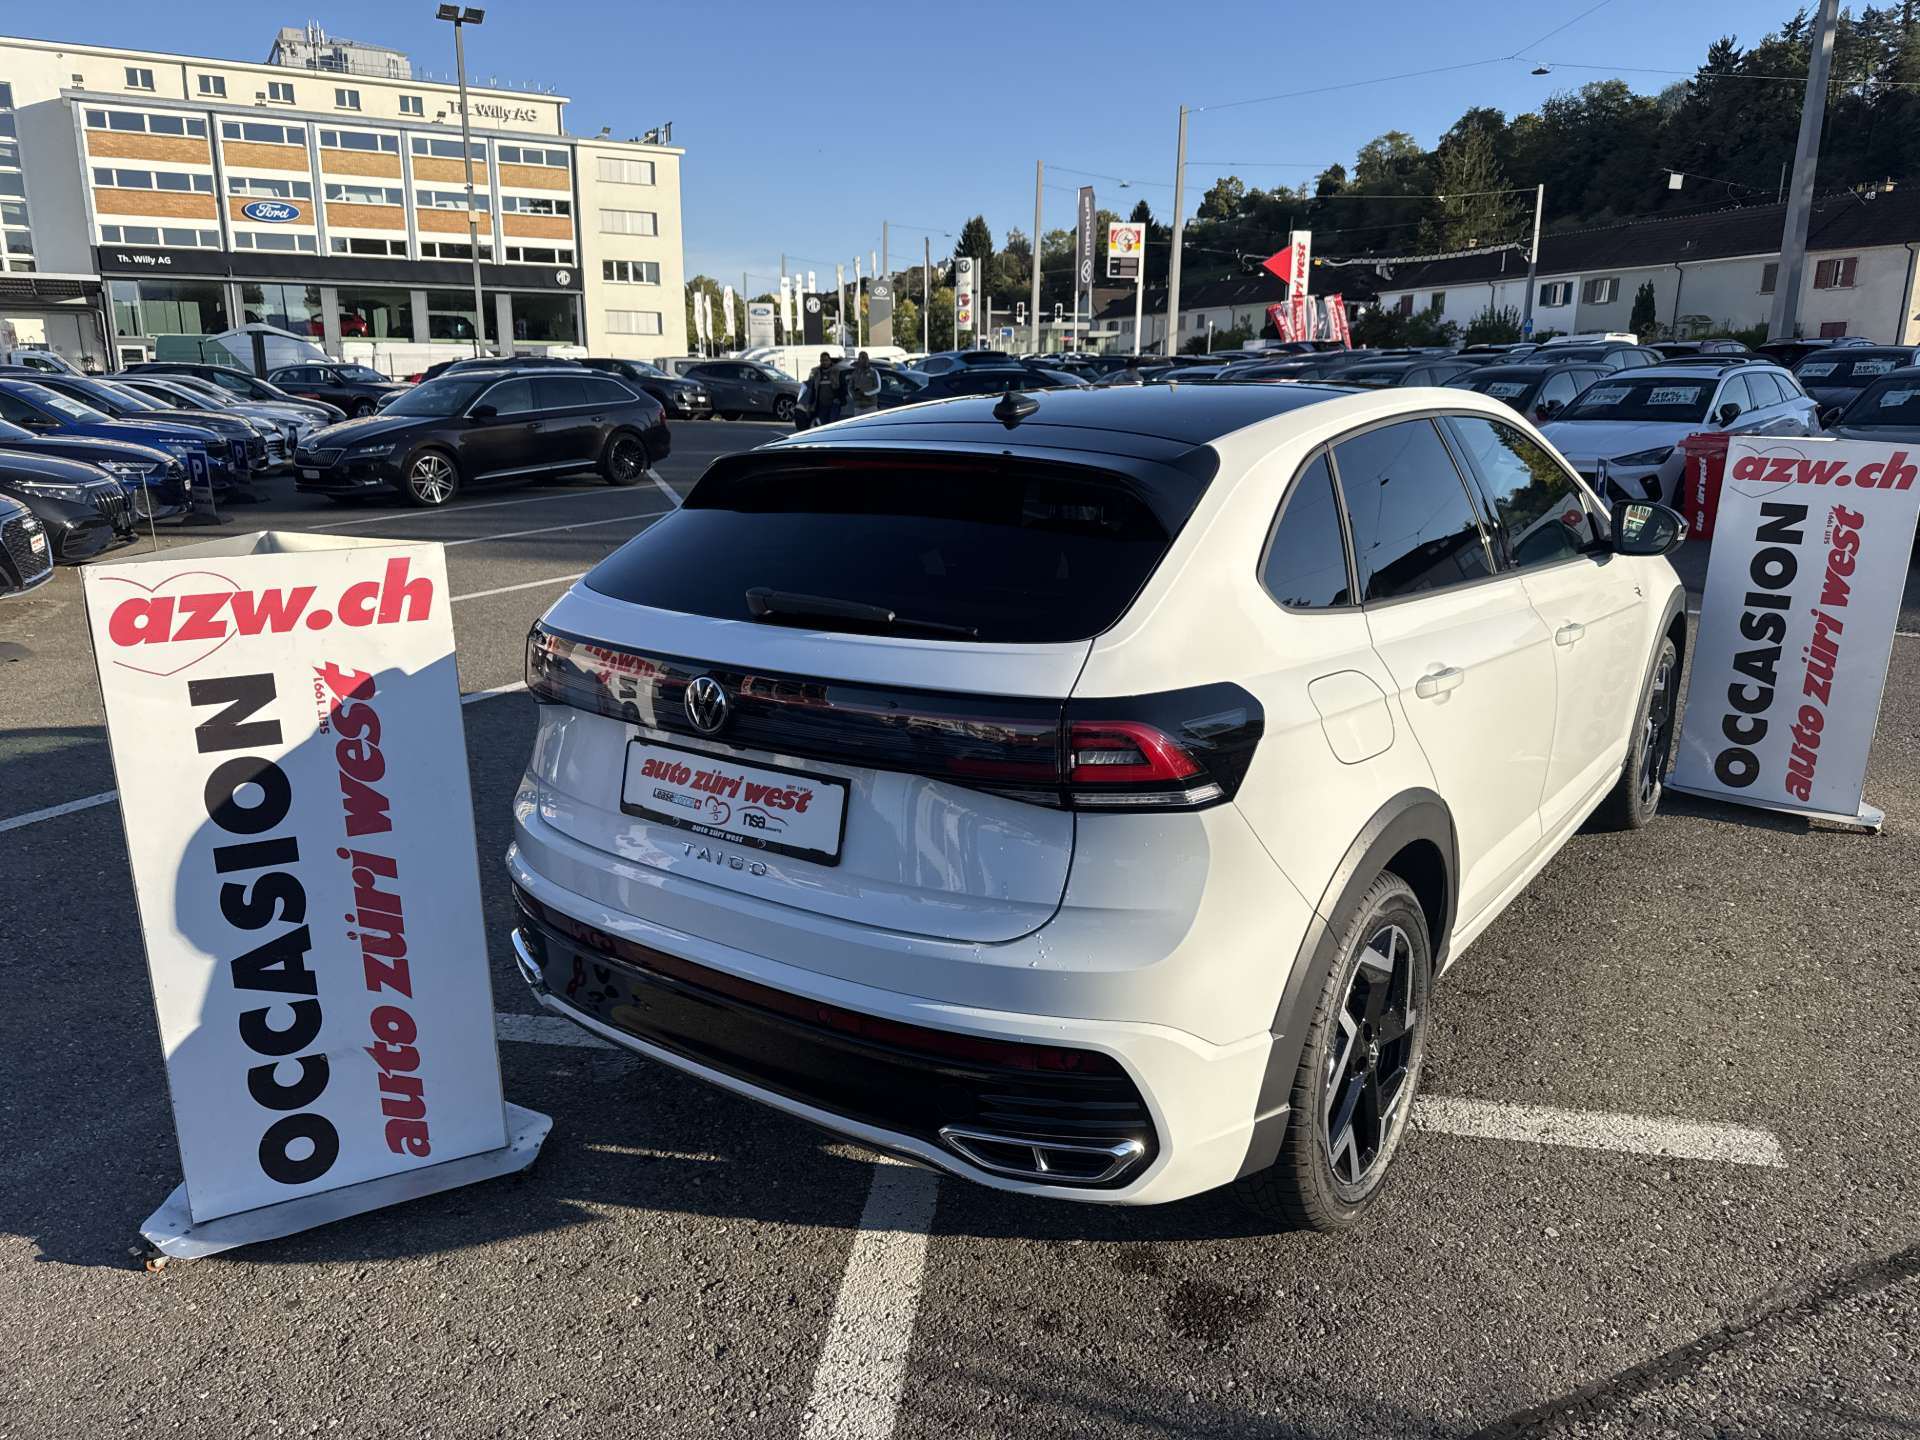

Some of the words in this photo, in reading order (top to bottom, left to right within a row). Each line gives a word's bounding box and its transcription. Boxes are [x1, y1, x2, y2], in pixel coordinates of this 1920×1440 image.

[474, 103, 509, 122] Willy
[512, 108, 537, 121] AG
[256, 203, 290, 219] Ford
[117, 254, 132, 263] Th.
[132, 255, 156, 266] Willy
[157, 256, 171, 264] AG
[1296, 241, 1306, 279] west
[192, 459, 203, 482] P
[1732, 451, 1918, 490] azw.ch
[1820, 503, 1865, 607] west
[1823, 530, 1832, 545] SEIT
[109, 556, 434, 648] azw.ch
[1714, 502, 1809, 789] OCCASION
[1801, 608, 1844, 706] züri
[313, 677, 326, 706] 1991
[317, 710, 331, 735] SEIT
[312, 660, 393, 838] west
[1785, 704, 1825, 802] auto
[641, 758, 692, 786] auto
[690, 769, 745, 798] züri
[745, 783, 814, 814] west
[691, 824, 708, 834] auto
[708, 828, 726, 839] züri
[725, 834, 744, 844] west
[743, 813, 766, 829] nsa
[681, 842, 767, 876] TAIGO
[188, 673, 341, 1186] OCCASION
[336, 846, 413, 1000] züri
[362, 1005, 432, 1158] auto
